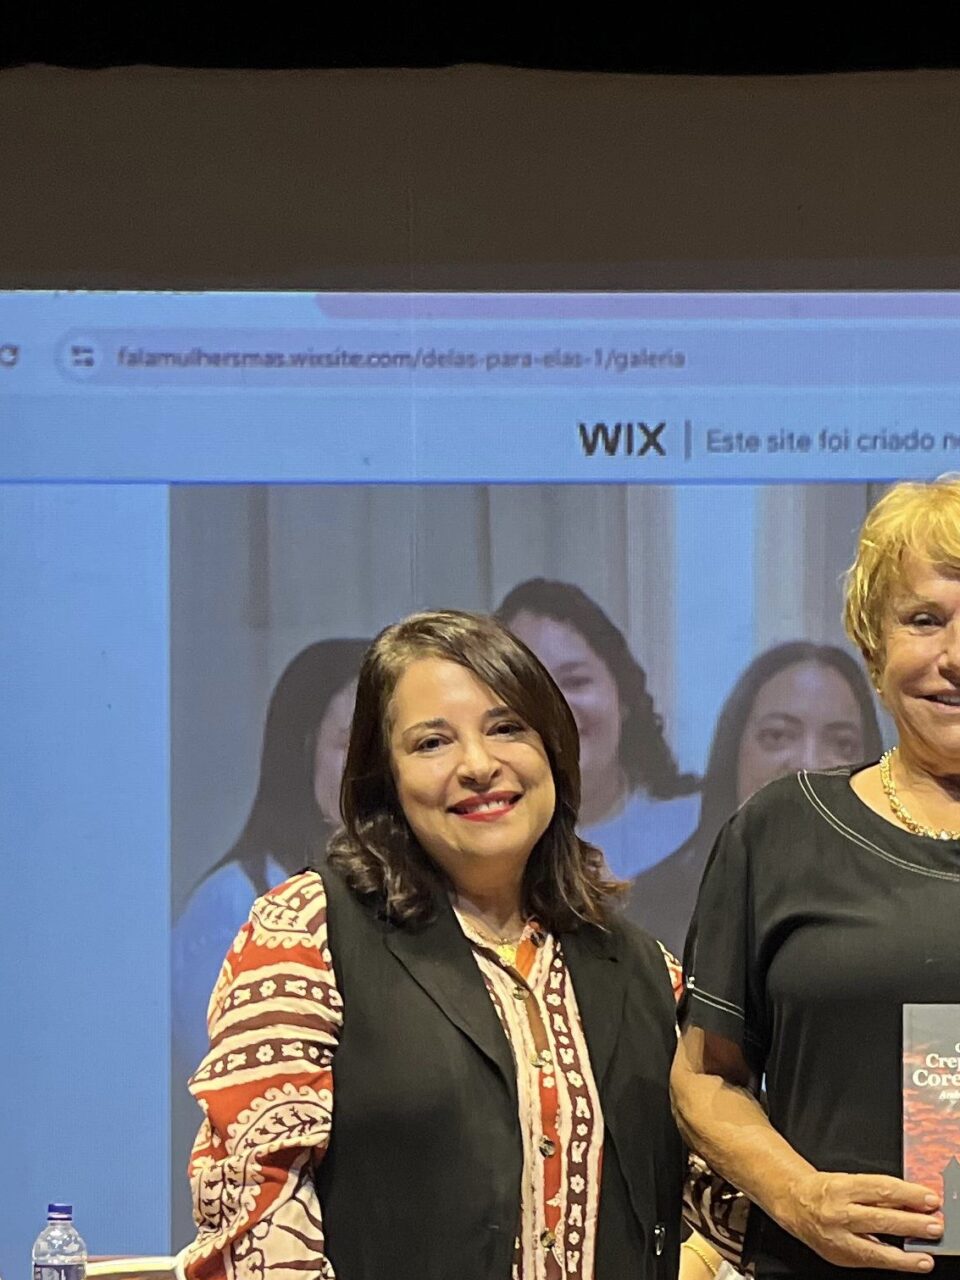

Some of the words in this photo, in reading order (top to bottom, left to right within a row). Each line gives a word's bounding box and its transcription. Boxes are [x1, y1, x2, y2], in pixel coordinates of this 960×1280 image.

[579, 422, 667, 457] WIX
[706, 428, 761, 453] Este
[766, 428, 811, 452] site
[819, 428, 850, 452] foi
[857, 428, 935, 452] criado
